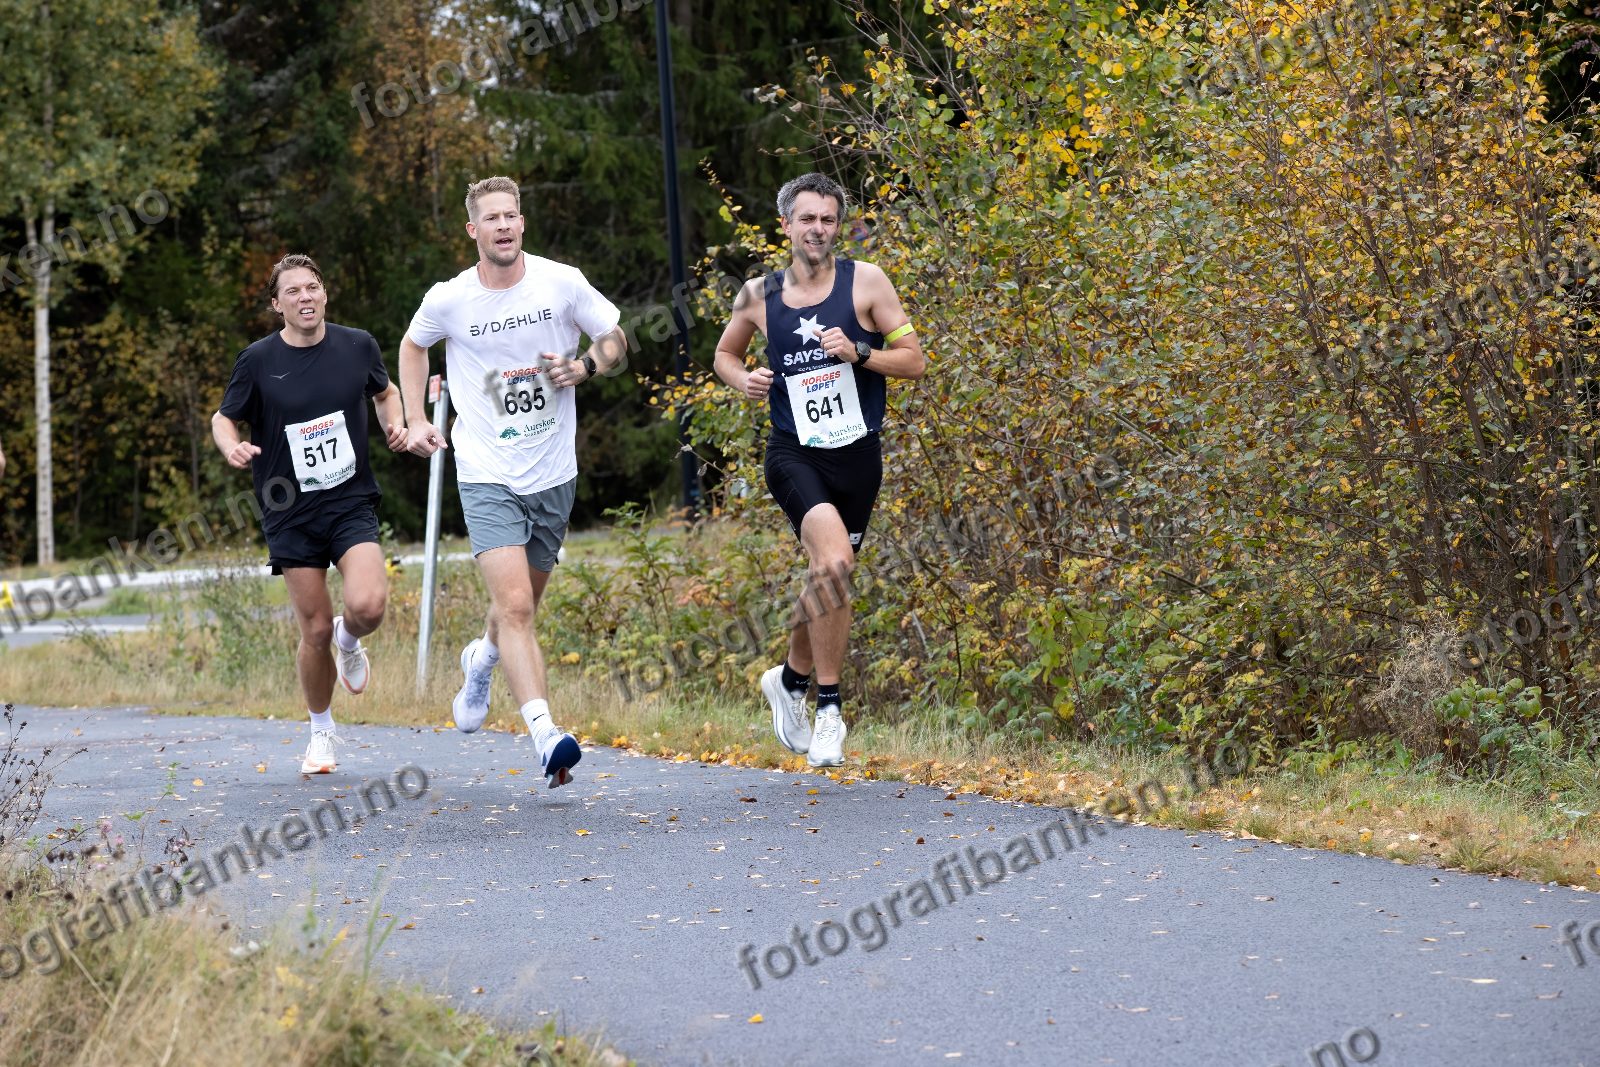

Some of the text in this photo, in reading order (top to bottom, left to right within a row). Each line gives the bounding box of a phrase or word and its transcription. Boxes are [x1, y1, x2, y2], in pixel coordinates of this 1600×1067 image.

[502, 366, 543, 379] NORGES
[506, 374, 537, 386] LØPET
[800, 370, 841, 387] NORGES
[806, 380, 836, 394] LØPET
[504, 386, 546, 416] 635
[805, 392, 845, 424] 641
[299, 419, 335, 435] NORGES
[523, 417, 556, 433] Aurskog
[304, 428, 330, 441] LØPET
[303, 437, 338, 468] 517
